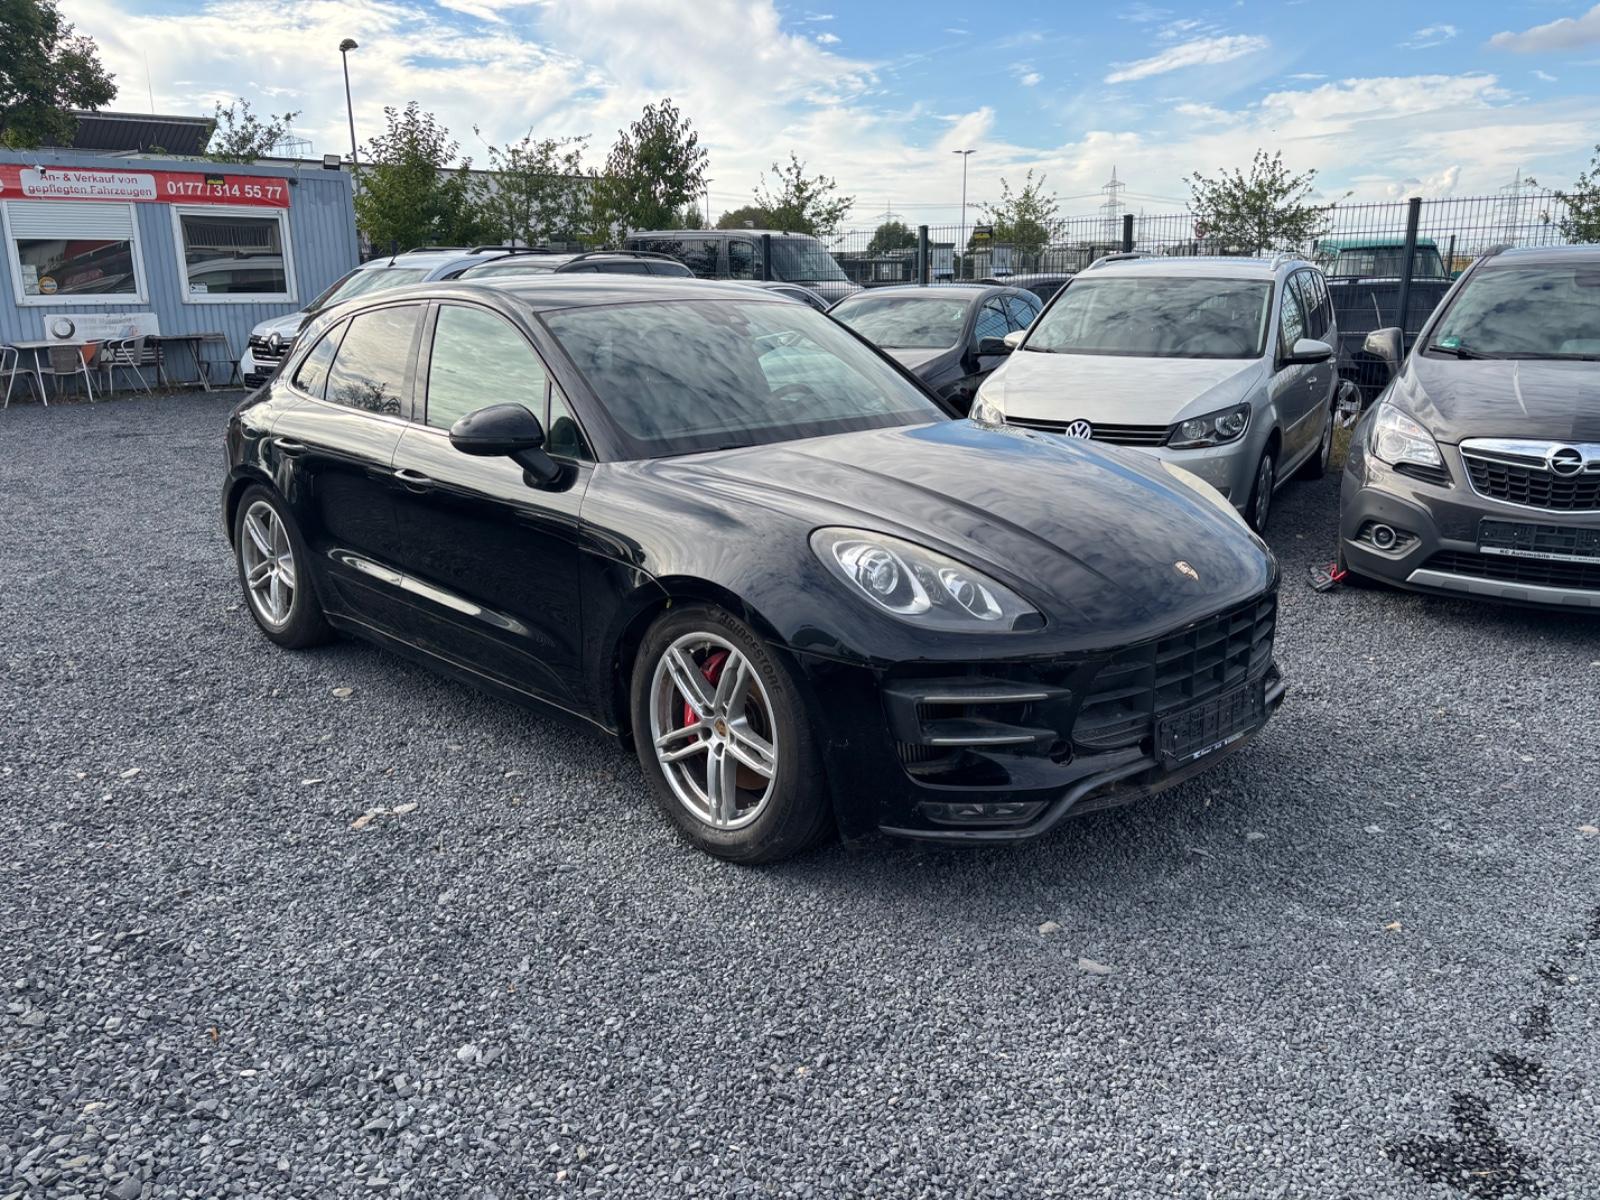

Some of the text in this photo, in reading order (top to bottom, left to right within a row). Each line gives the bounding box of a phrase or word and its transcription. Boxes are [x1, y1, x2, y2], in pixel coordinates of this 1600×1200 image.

[40, 173, 138, 185] An- & Verkauf von
[28, 183, 152, 197] gepflegten Fahrzeugen
[167, 181, 203, 196] 0177
[213, 184, 241, 197] 314
[244, 185, 262, 198] 55
[265, 186, 282, 199] 77
